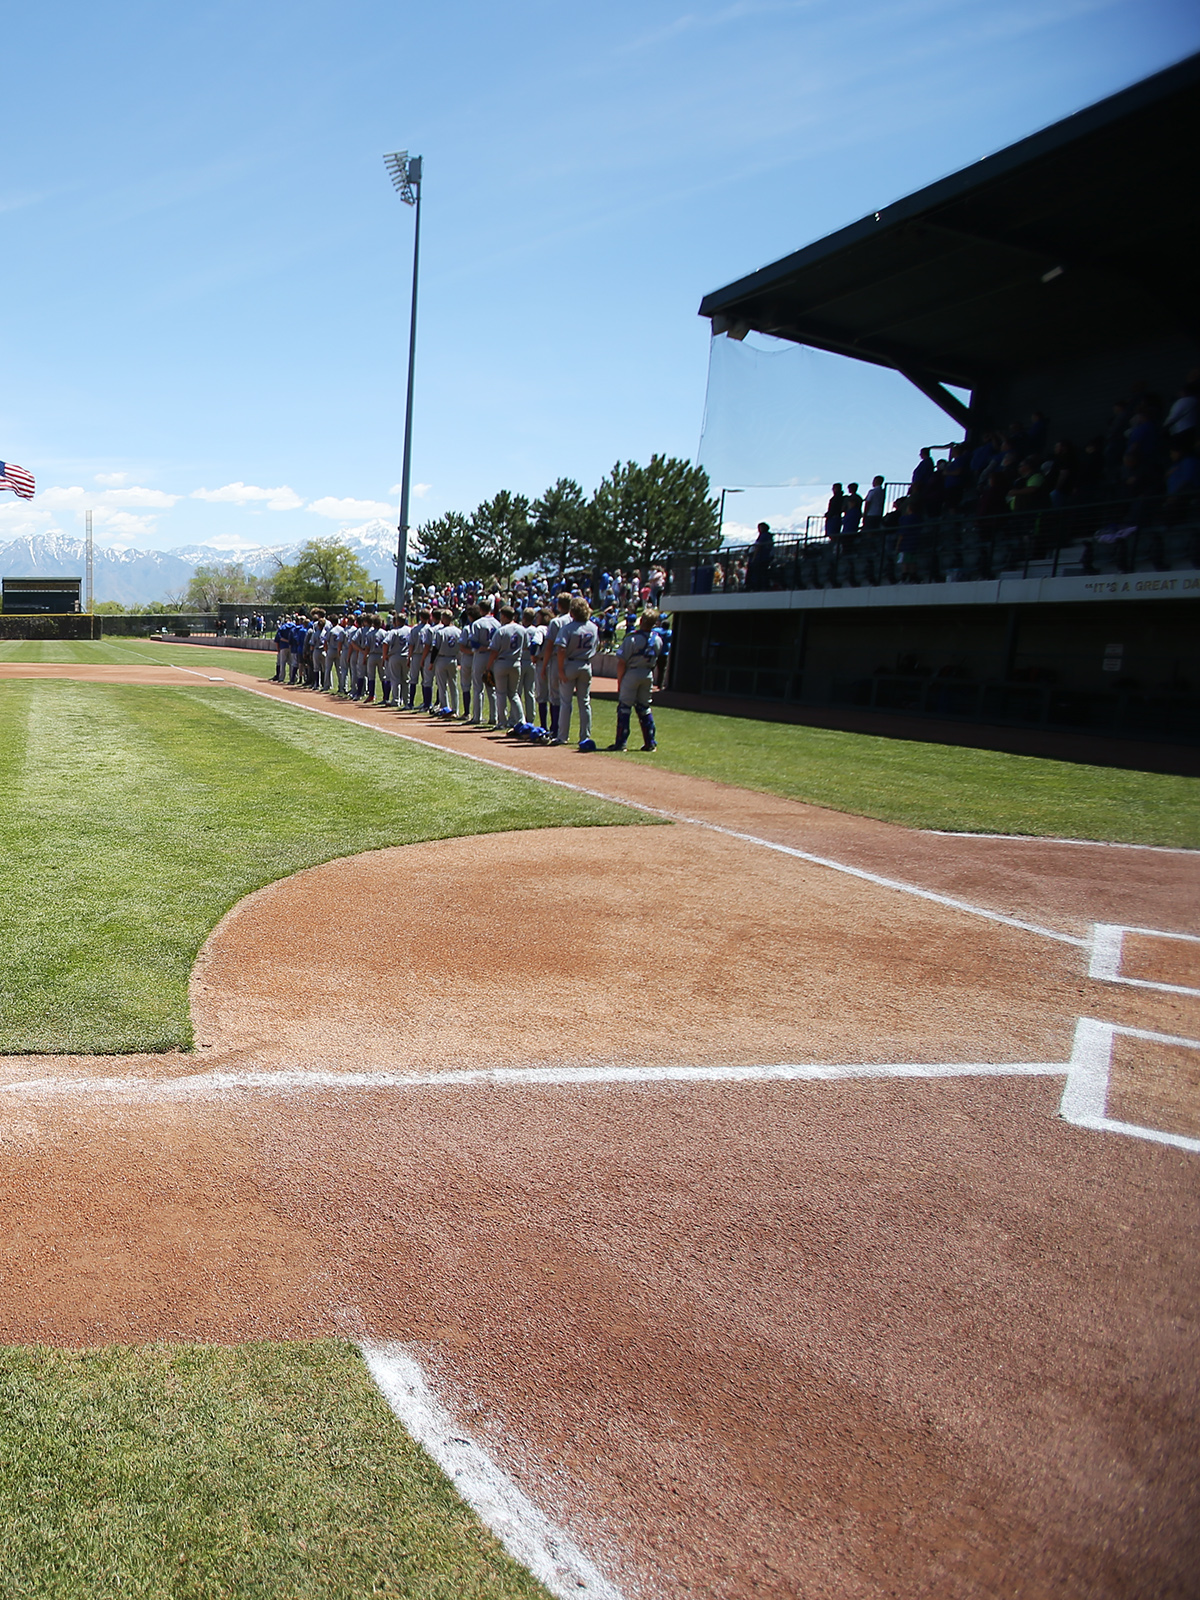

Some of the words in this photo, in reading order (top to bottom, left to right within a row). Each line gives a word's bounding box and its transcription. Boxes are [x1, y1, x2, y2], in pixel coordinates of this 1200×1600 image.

[1121, 581, 1130, 592] A
[1135, 579, 1177, 592] GREAT
[577, 633, 594, 649] 12
